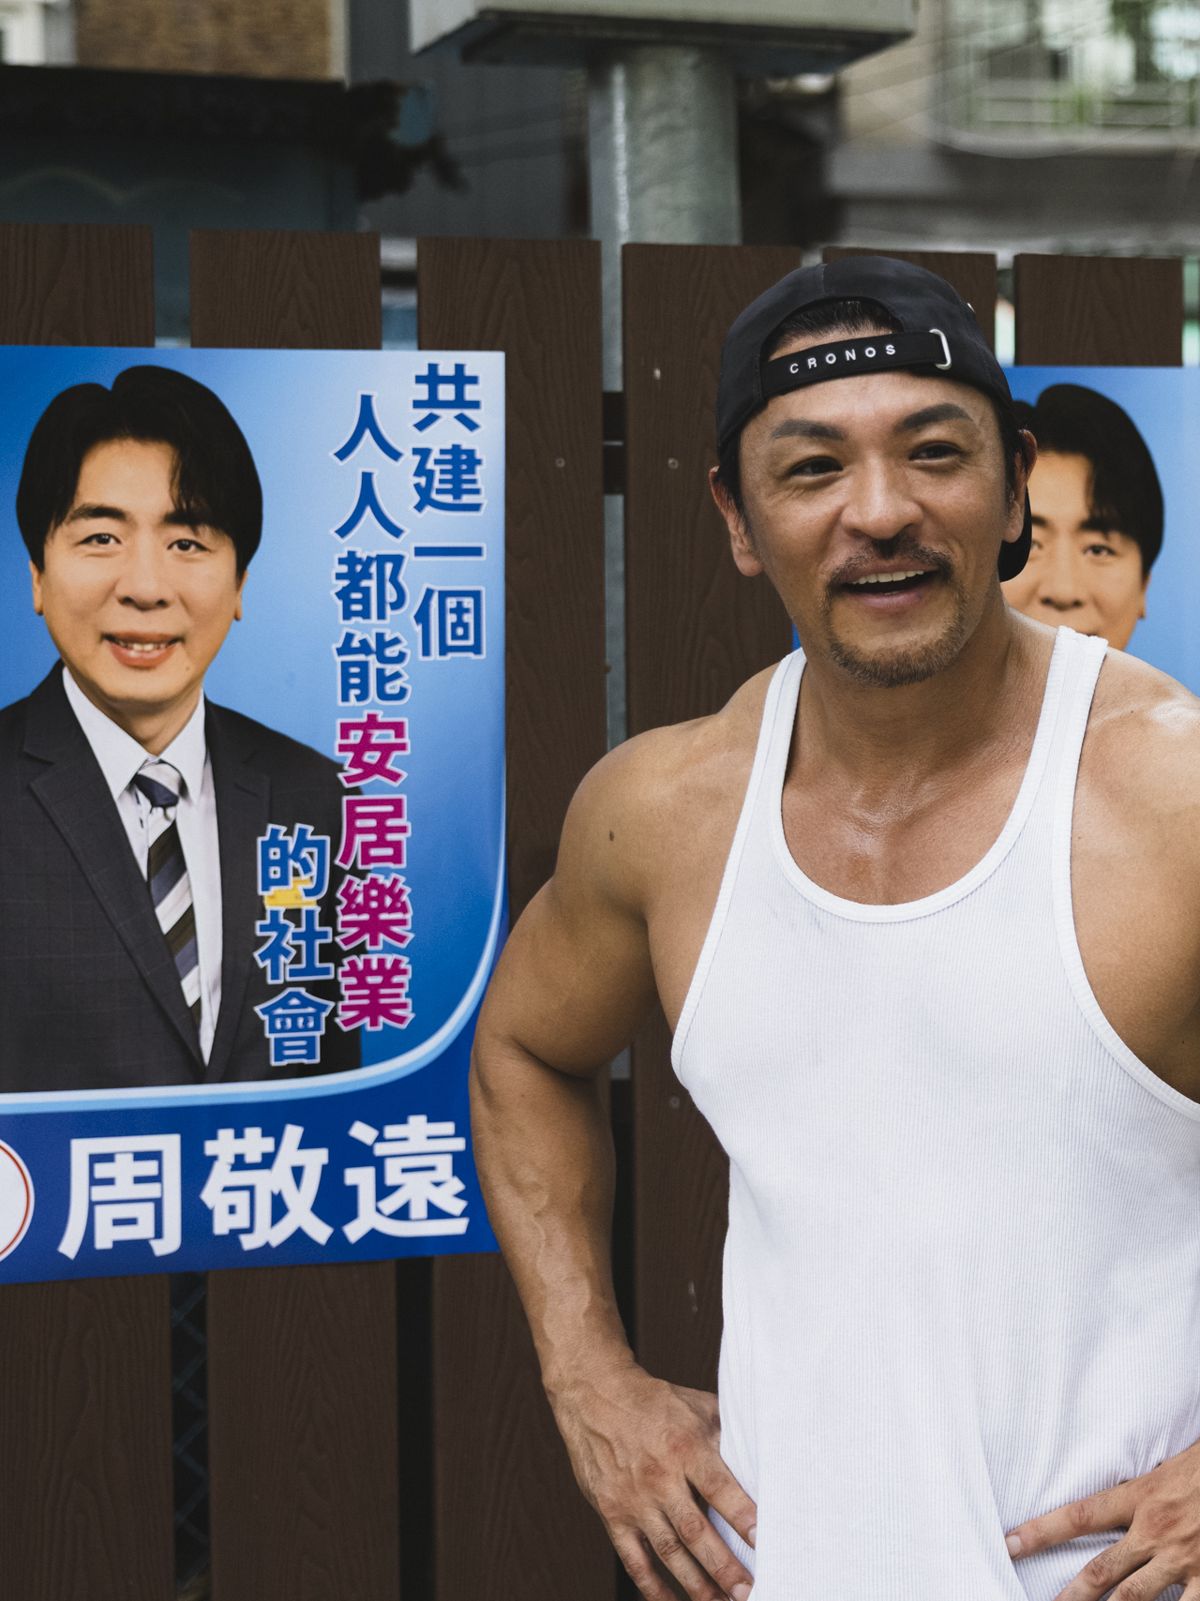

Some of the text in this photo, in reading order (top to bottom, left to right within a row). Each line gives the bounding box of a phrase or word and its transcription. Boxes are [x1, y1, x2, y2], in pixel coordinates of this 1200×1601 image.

[788, 343, 897, 375] CRONOS
[411, 361, 485, 660] 共建一個
[333, 393, 412, 1031] 人人都能安居樂業
[254, 825, 335, 1066] 的社會
[57, 1114, 471, 1260] 周敬遠
